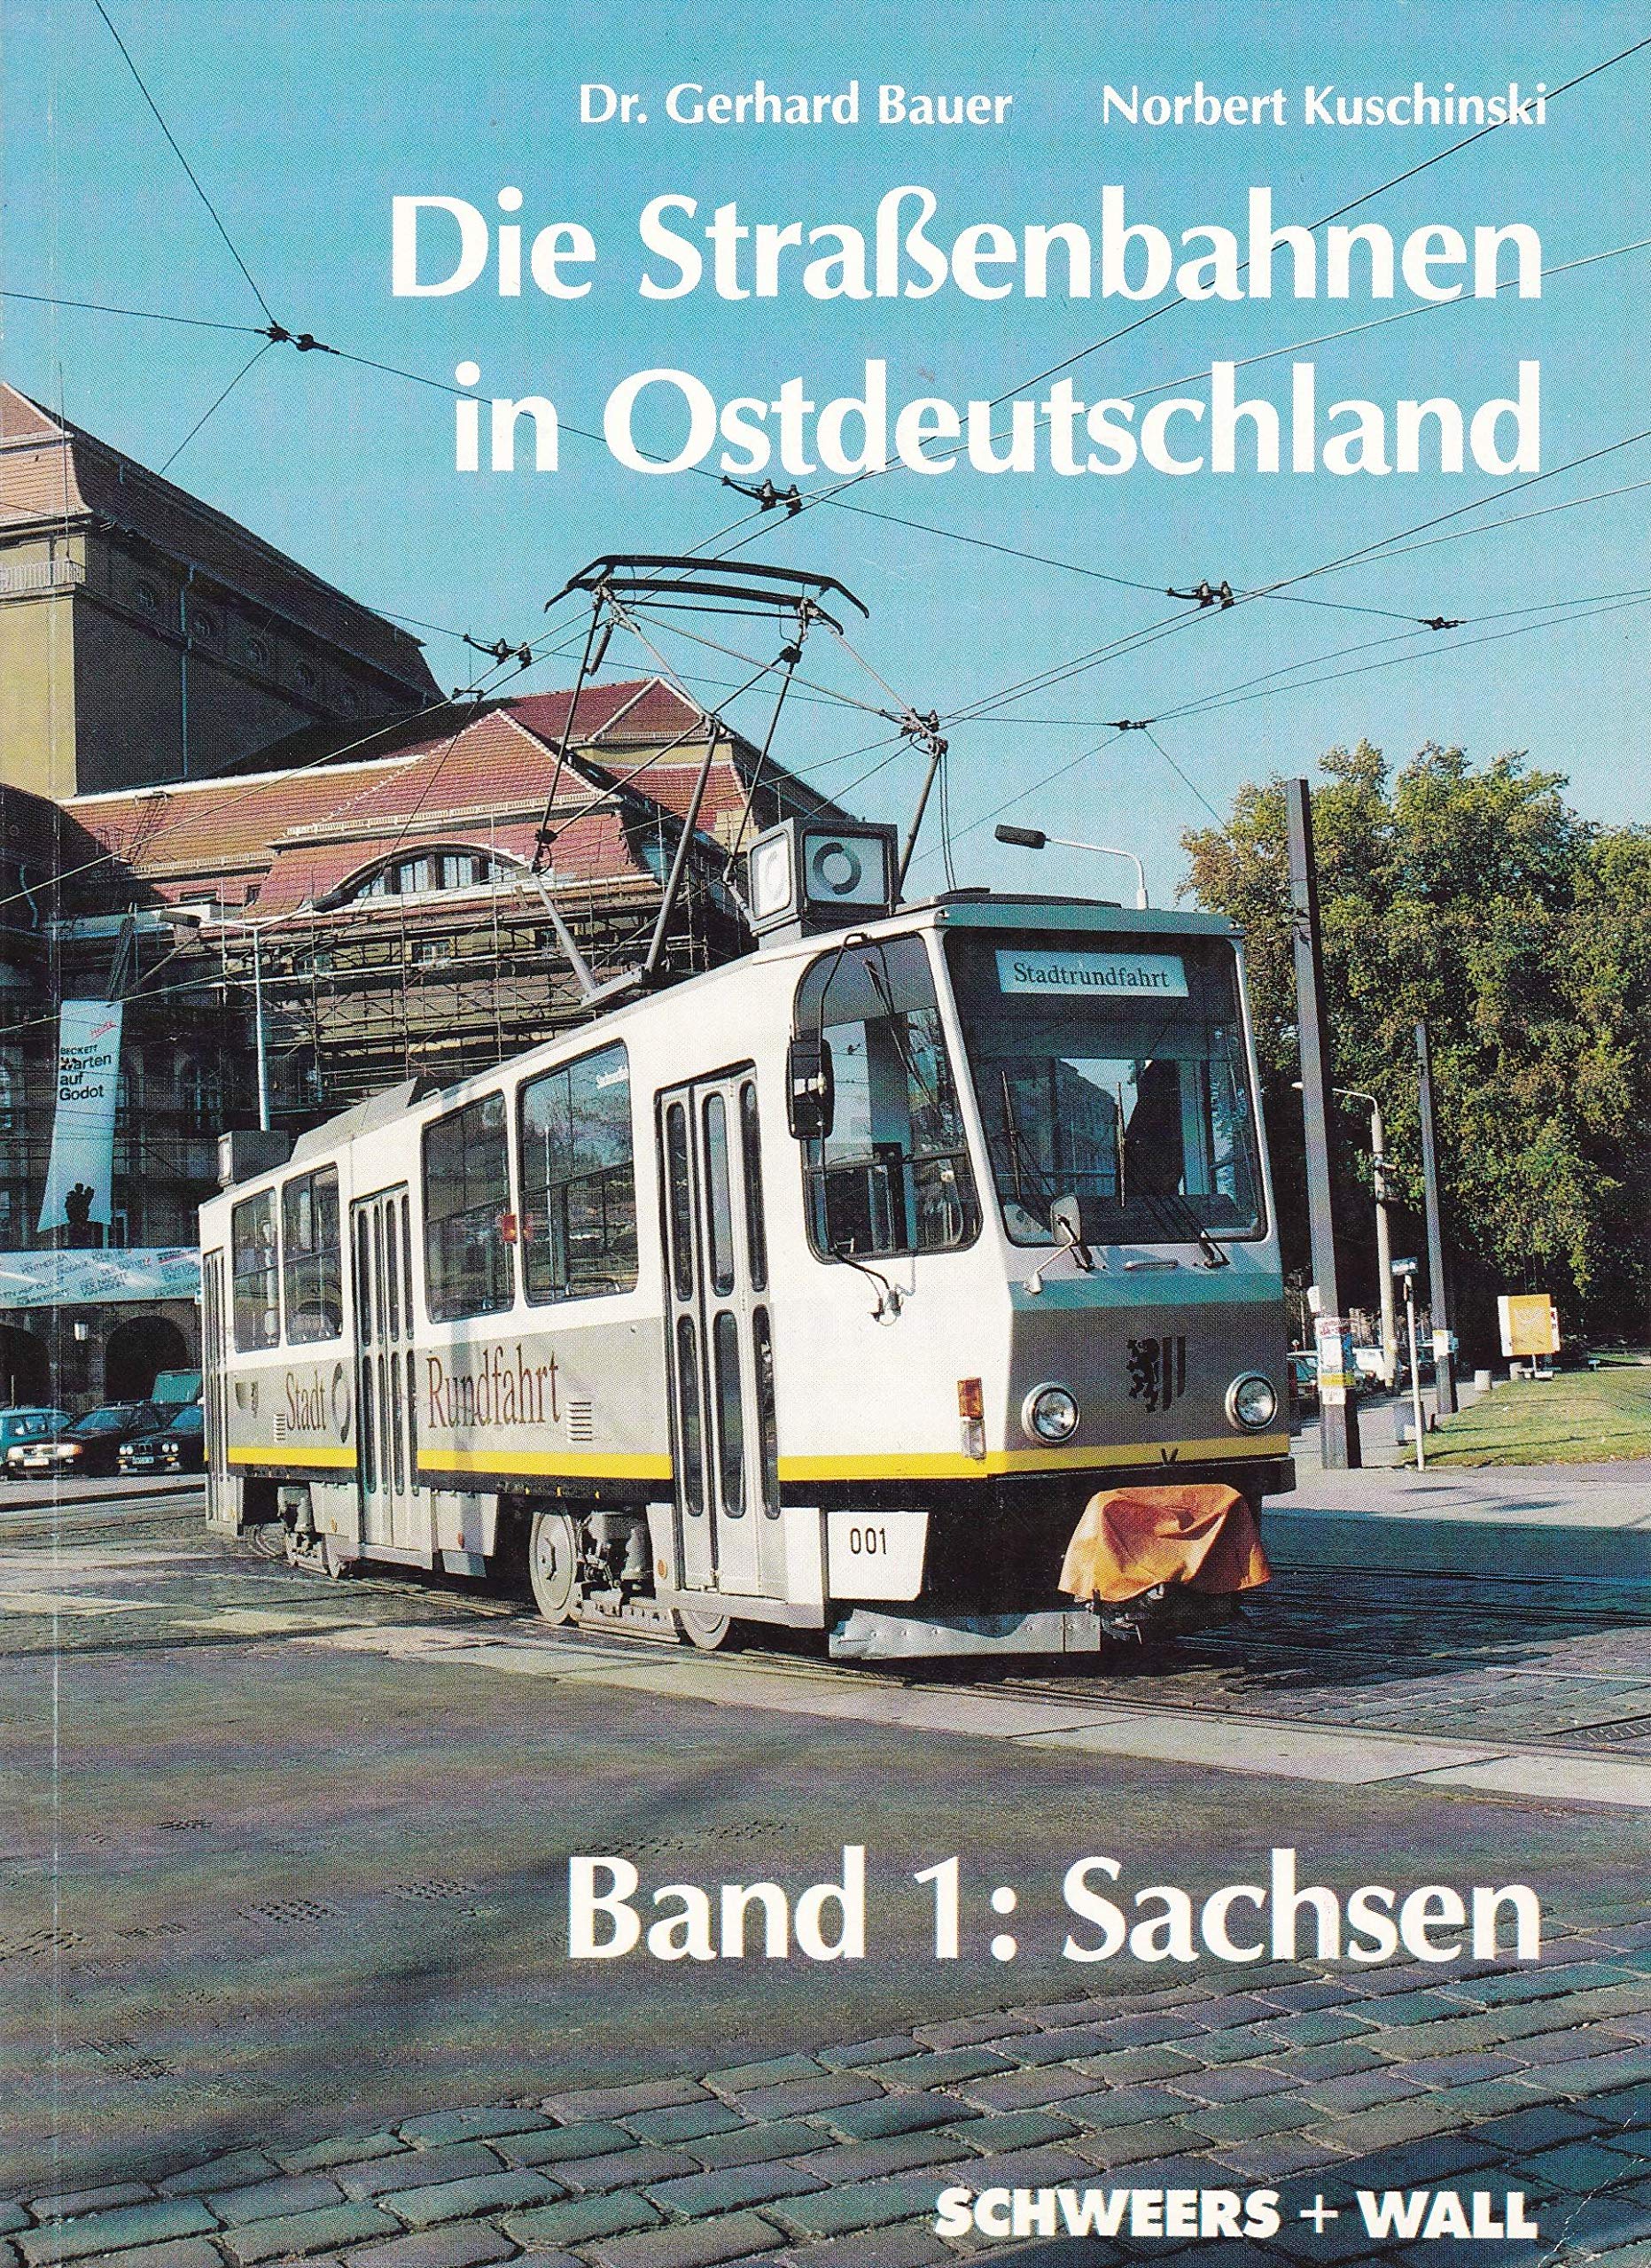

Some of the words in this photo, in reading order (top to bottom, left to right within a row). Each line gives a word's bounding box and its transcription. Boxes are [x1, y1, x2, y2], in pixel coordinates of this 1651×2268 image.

[1013, 961, 1171, 989] Stadtrundfahrt
[59, 1070, 84, 1086] auf
[59, 1084, 105, 1101] Godot
[285, 1367, 327, 1431] Stadt
[426, 1342, 562, 1428] Rundfahrt
[850, 1527, 887, 1555] 001
